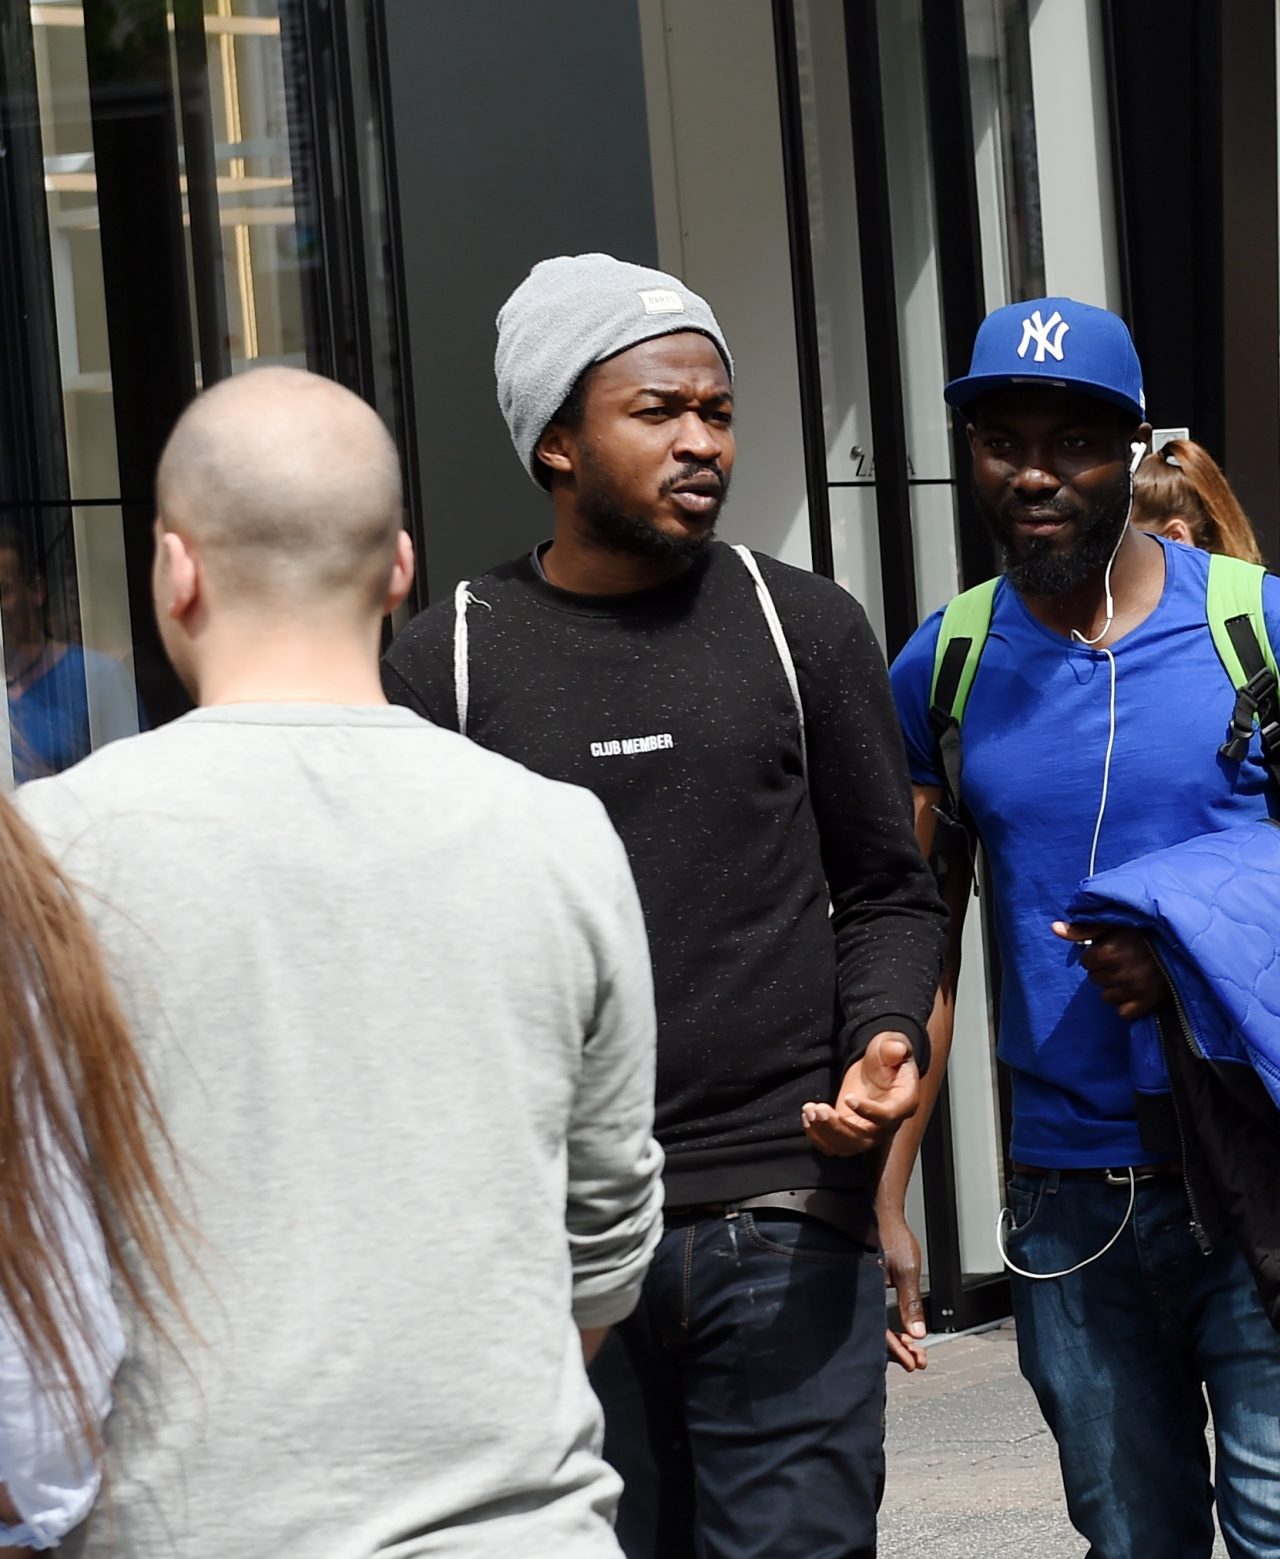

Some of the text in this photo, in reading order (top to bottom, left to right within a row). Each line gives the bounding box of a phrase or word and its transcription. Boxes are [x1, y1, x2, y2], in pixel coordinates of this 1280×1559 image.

[1017, 310, 1070, 362] NY
[590, 733, 674, 757] CLUB MEMBER
